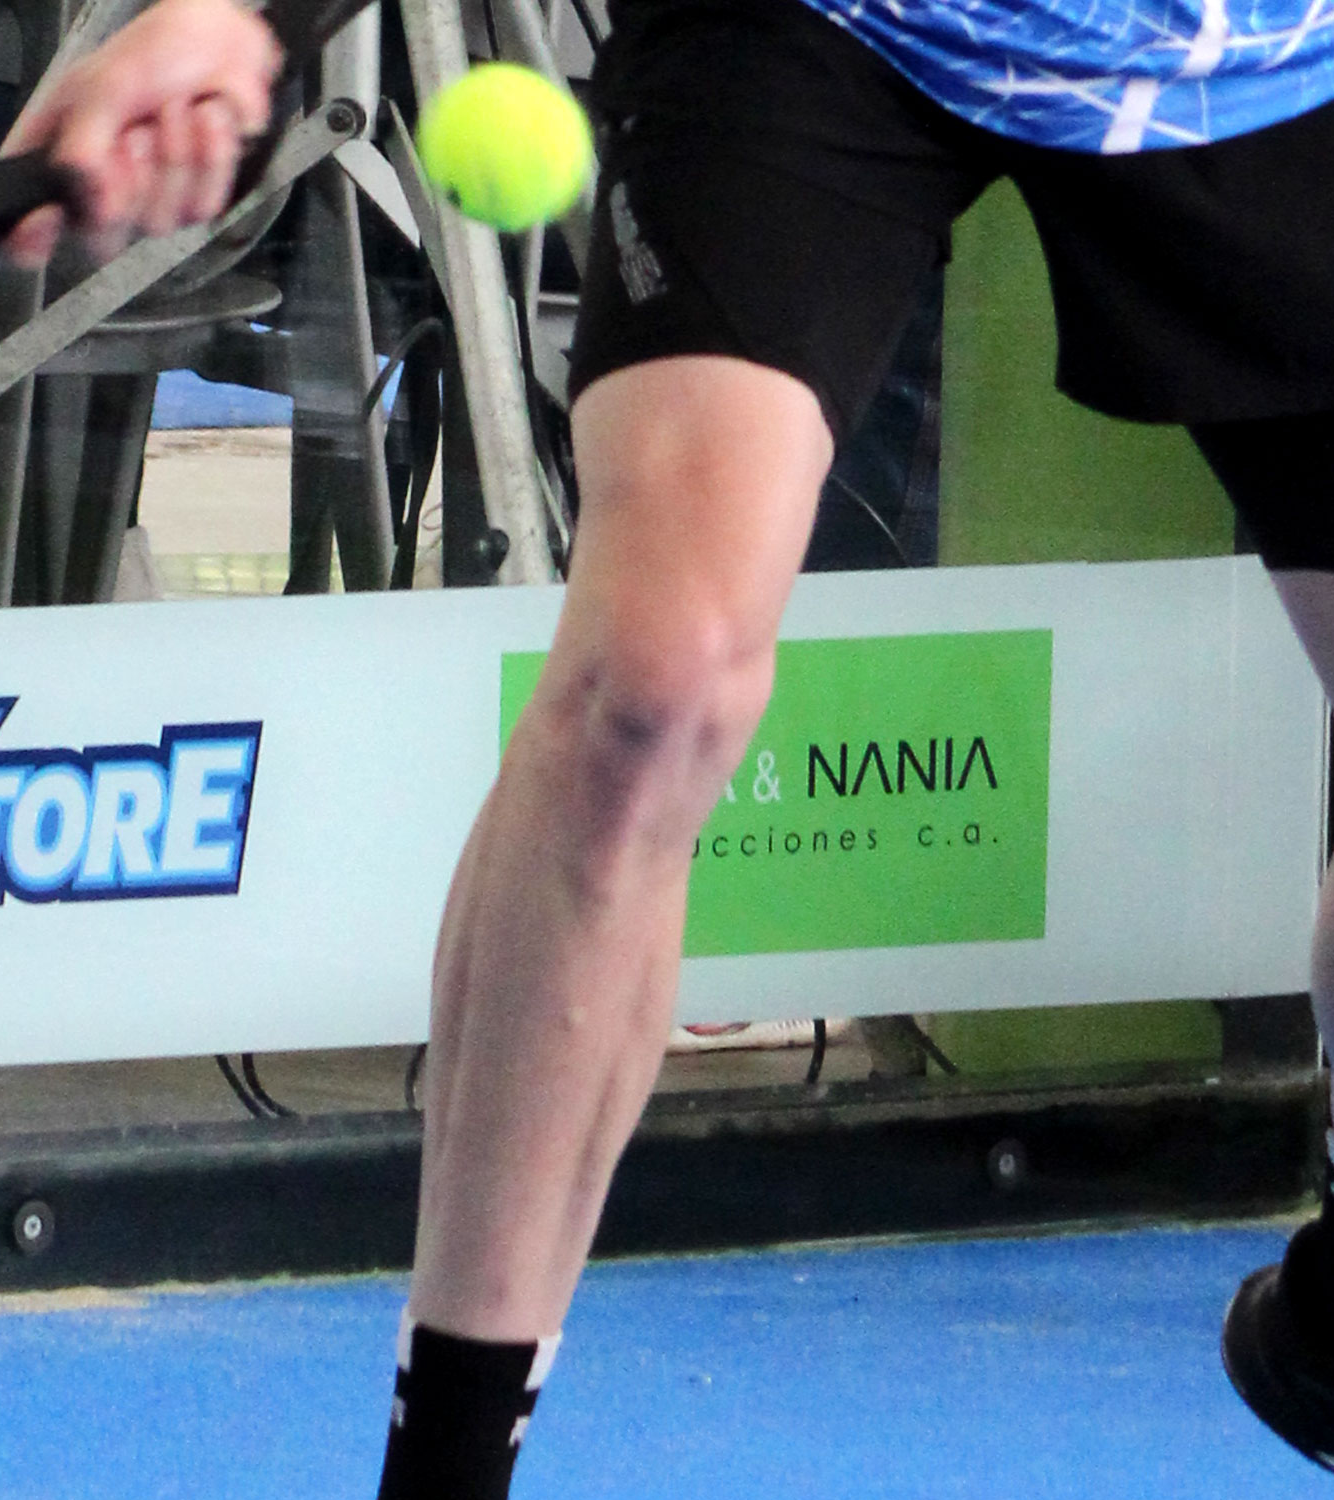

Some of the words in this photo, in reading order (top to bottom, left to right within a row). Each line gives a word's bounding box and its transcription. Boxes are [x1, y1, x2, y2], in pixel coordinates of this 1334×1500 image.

[752, 749, 782, 804] &
[807, 736, 999, 798] NANIA
[917, 821, 1000, 848] c.a.
